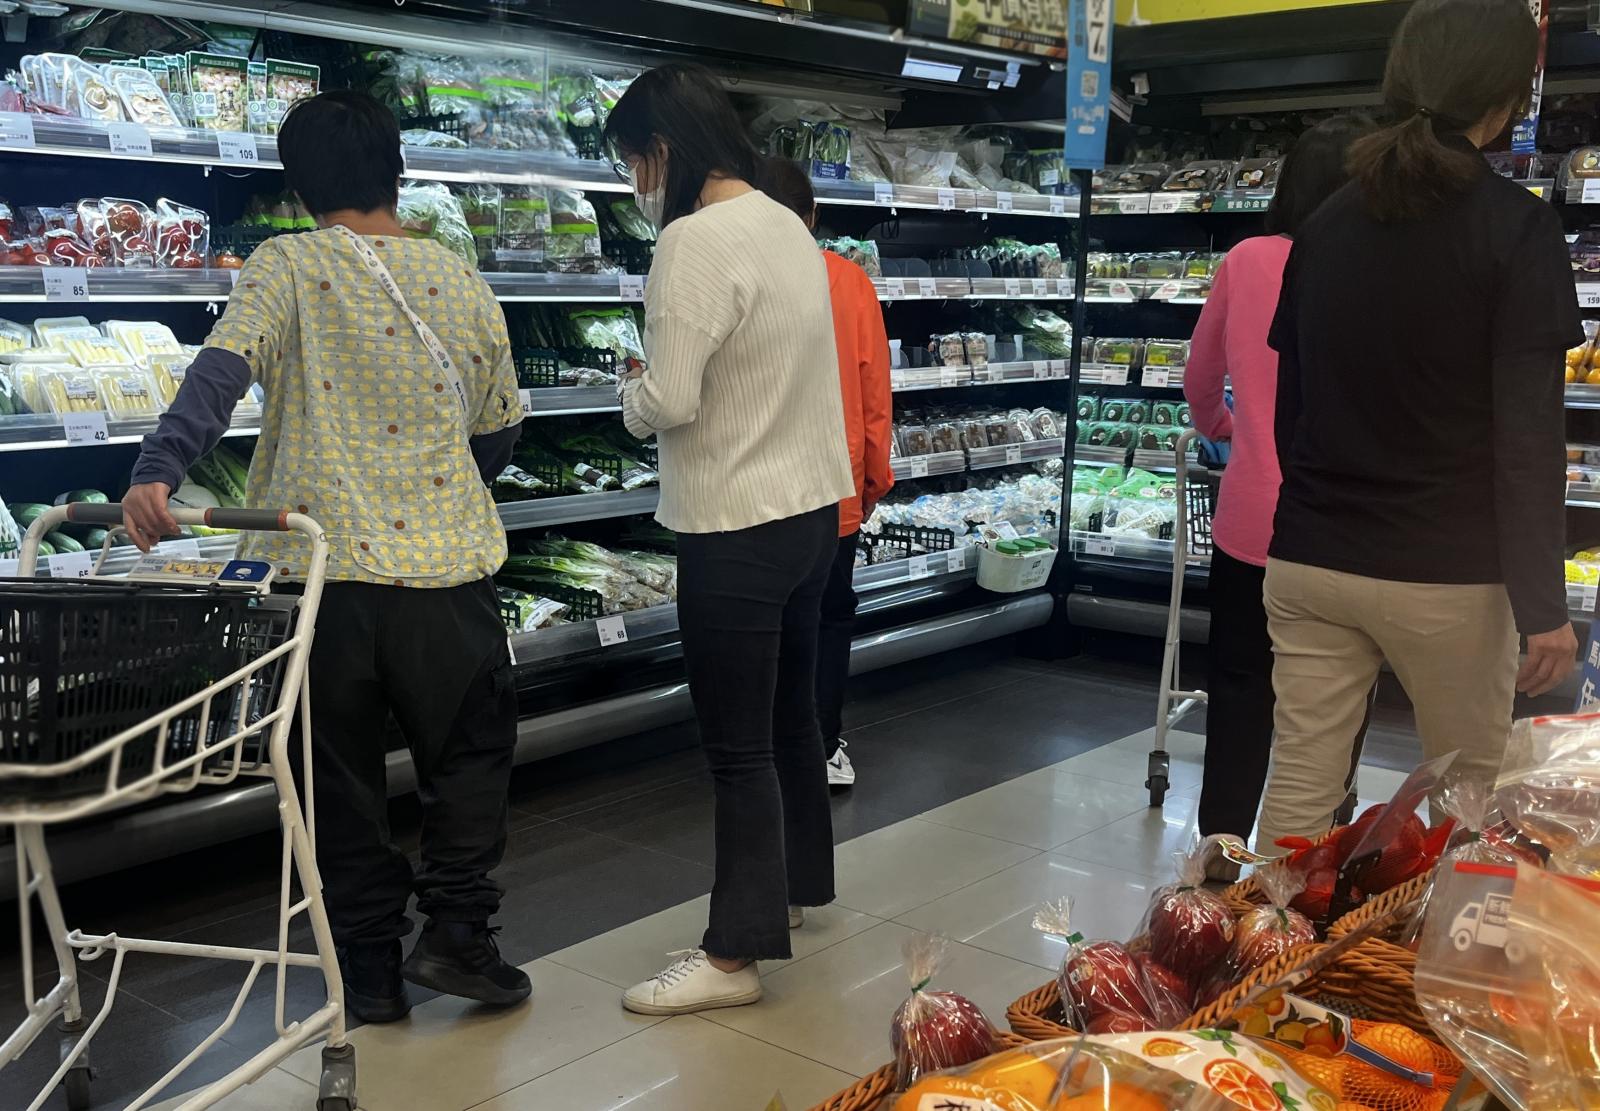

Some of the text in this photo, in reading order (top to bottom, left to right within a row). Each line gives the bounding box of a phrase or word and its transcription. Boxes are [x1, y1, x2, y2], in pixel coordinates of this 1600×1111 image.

[239, 149, 254, 160] 109
[73, 286, 84, 296] 85
[635, 289, 643, 298] 35
[94, 431, 106, 441] 42
[617, 630, 625, 639] 69
